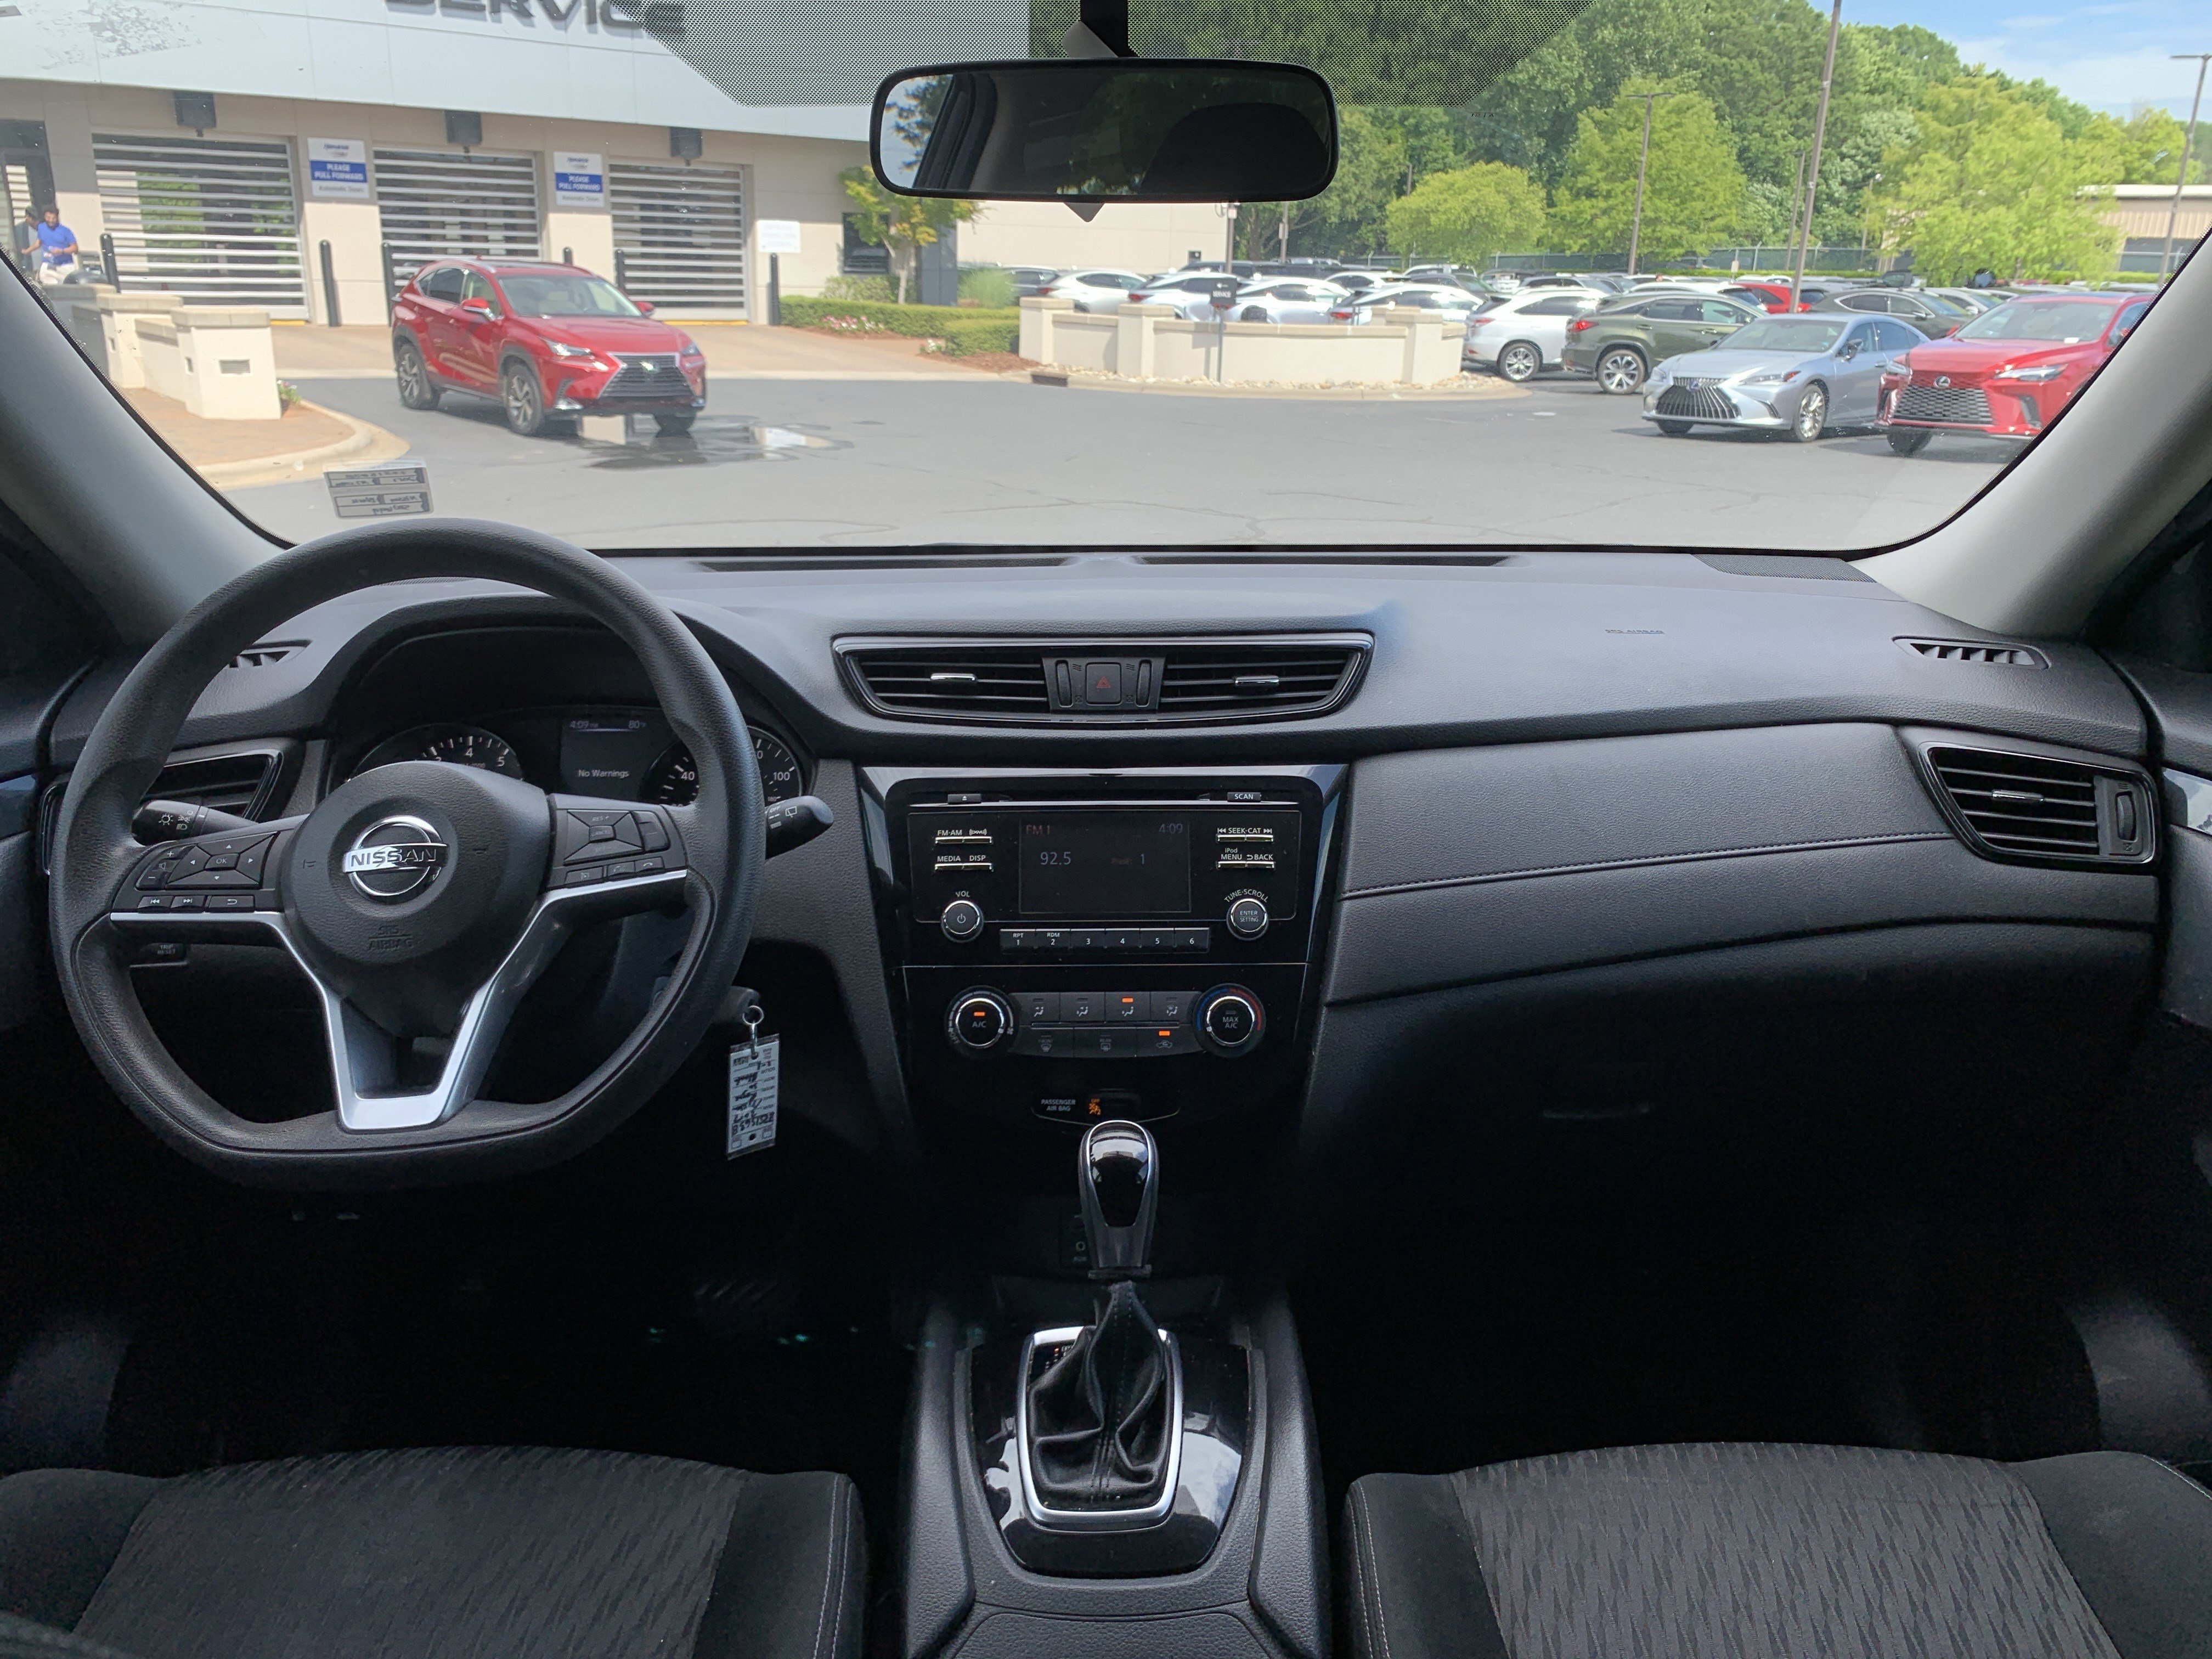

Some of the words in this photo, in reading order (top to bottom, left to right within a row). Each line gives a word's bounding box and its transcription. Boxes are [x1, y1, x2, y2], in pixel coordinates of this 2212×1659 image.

[466, 748, 473, 758] 4
[498, 756, 505, 767] 5
[578, 769, 590, 777] No
[591, 769, 630, 778] Warnings
[681, 771, 695, 780] 40
[773, 771, 791, 781] 100
[1159, 823, 1183, 834] 4:09
[351, 848, 437, 867] NISSAN
[1040, 851, 1071, 865] 92.5
